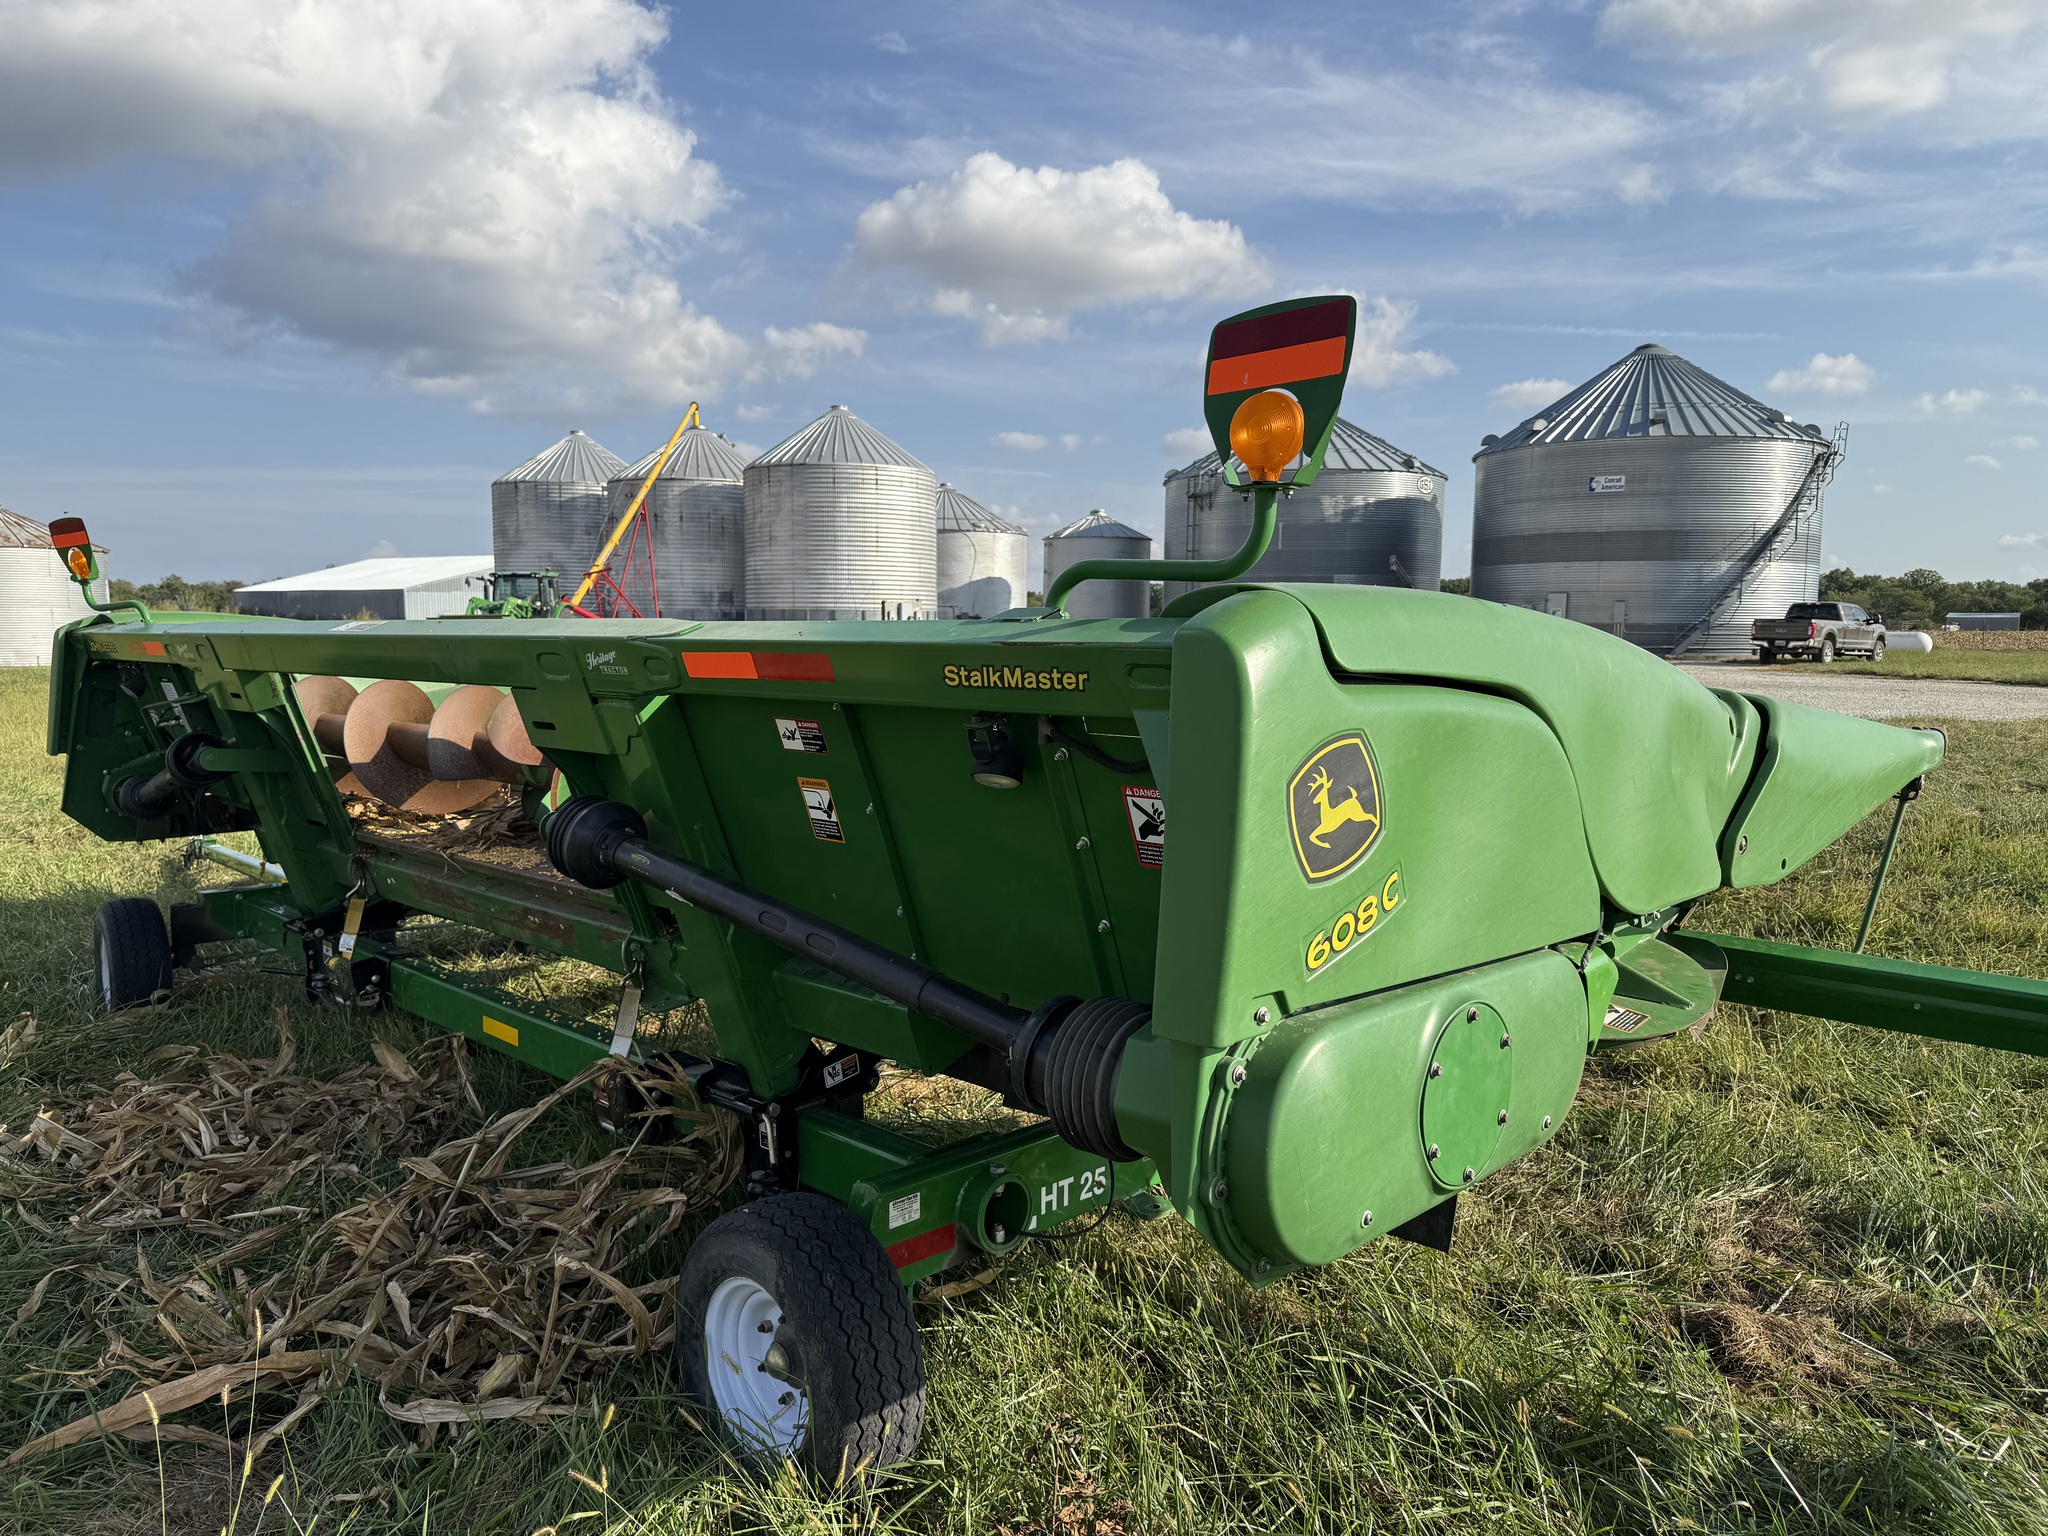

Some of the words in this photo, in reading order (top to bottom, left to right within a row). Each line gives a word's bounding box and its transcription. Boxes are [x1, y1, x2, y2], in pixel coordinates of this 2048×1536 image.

[585, 650, 616, 670] Heritage
[600, 665, 629, 675] TRACTOR
[943, 664, 1089, 692] StalkMaster
[1133, 788, 1161, 798] DANGE
[1041, 1176, 1074, 1215] HT
[1080, 1166, 1107, 1200] 25
